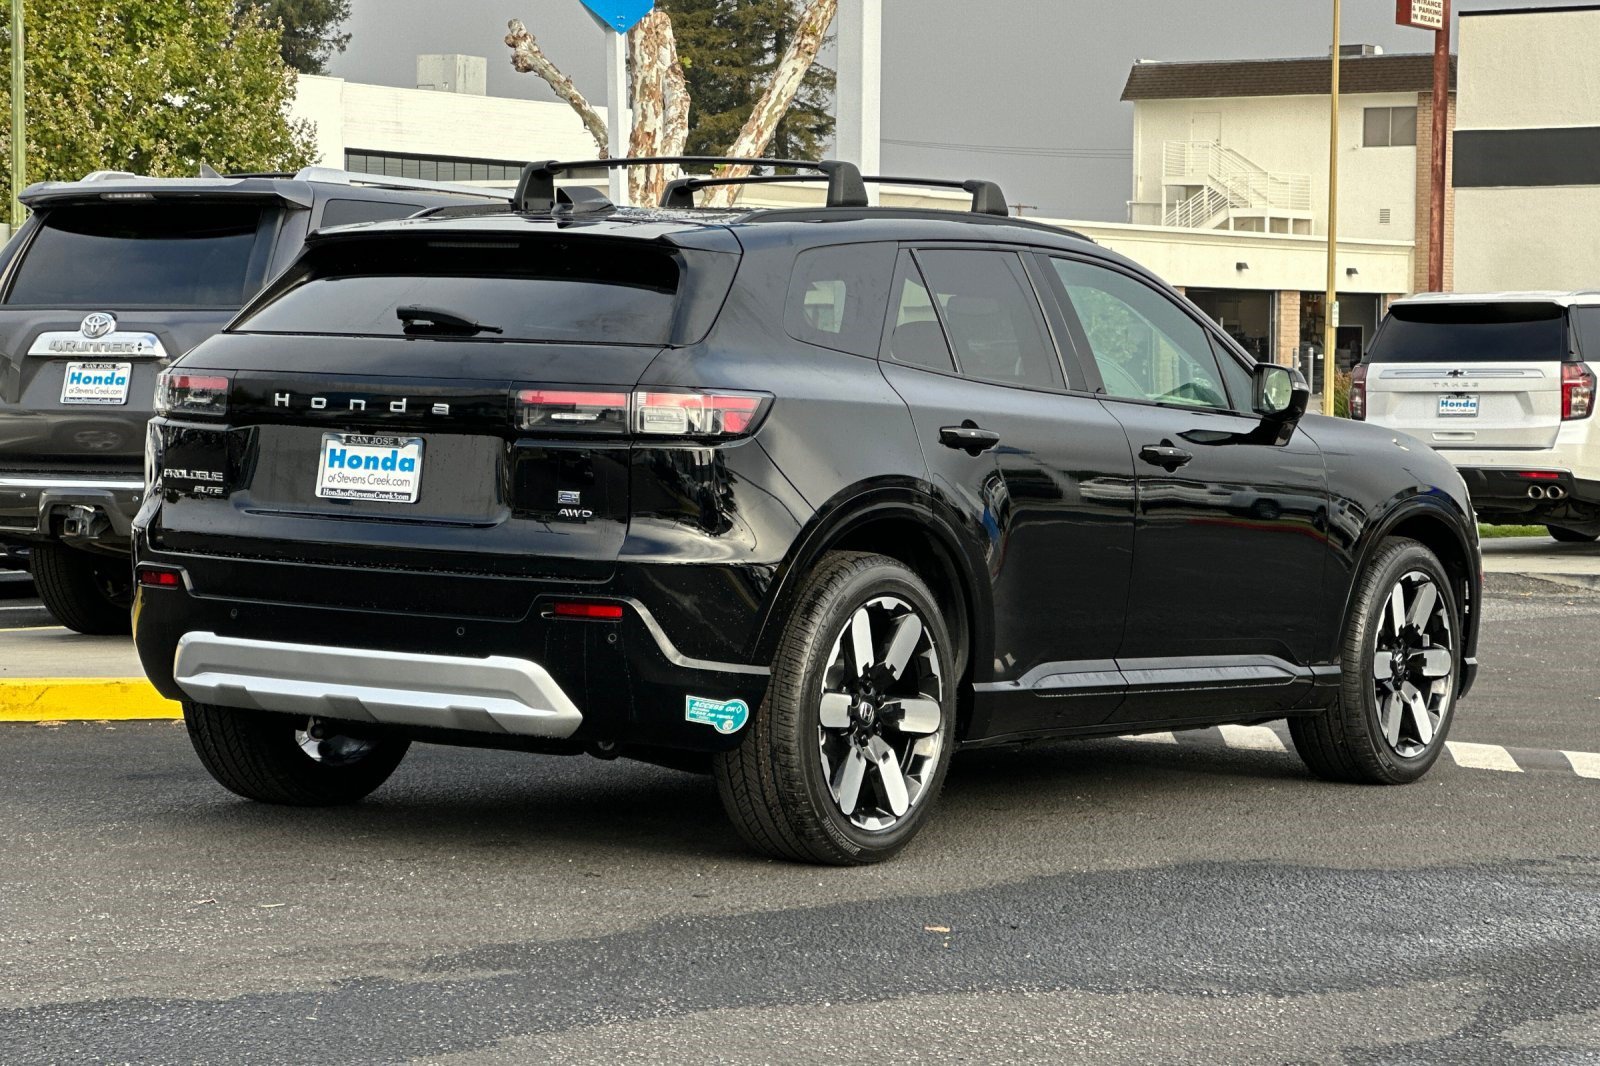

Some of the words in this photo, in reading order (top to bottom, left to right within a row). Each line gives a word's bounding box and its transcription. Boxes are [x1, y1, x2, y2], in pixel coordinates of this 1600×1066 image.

[1418, 6, 1442, 16] PARKING
[1420, 14, 1435, 23] REAR
[69, 371, 127, 386] Honda
[273, 392, 450, 416] Honda
[1440, 399, 1477, 408] Honda
[370, 437, 395, 445] JOSE
[327, 448, 416, 472] Honda
[163, 468, 224, 482] PROLOGUE
[327, 472, 337, 483] of
[337, 471, 366, 485] Stevens
[367, 473, 411, 487] Creek.com
[193, 485, 224, 494] ELITE
[557, 508, 593, 518] AWD
[693, 701, 724, 711] ACCESS
